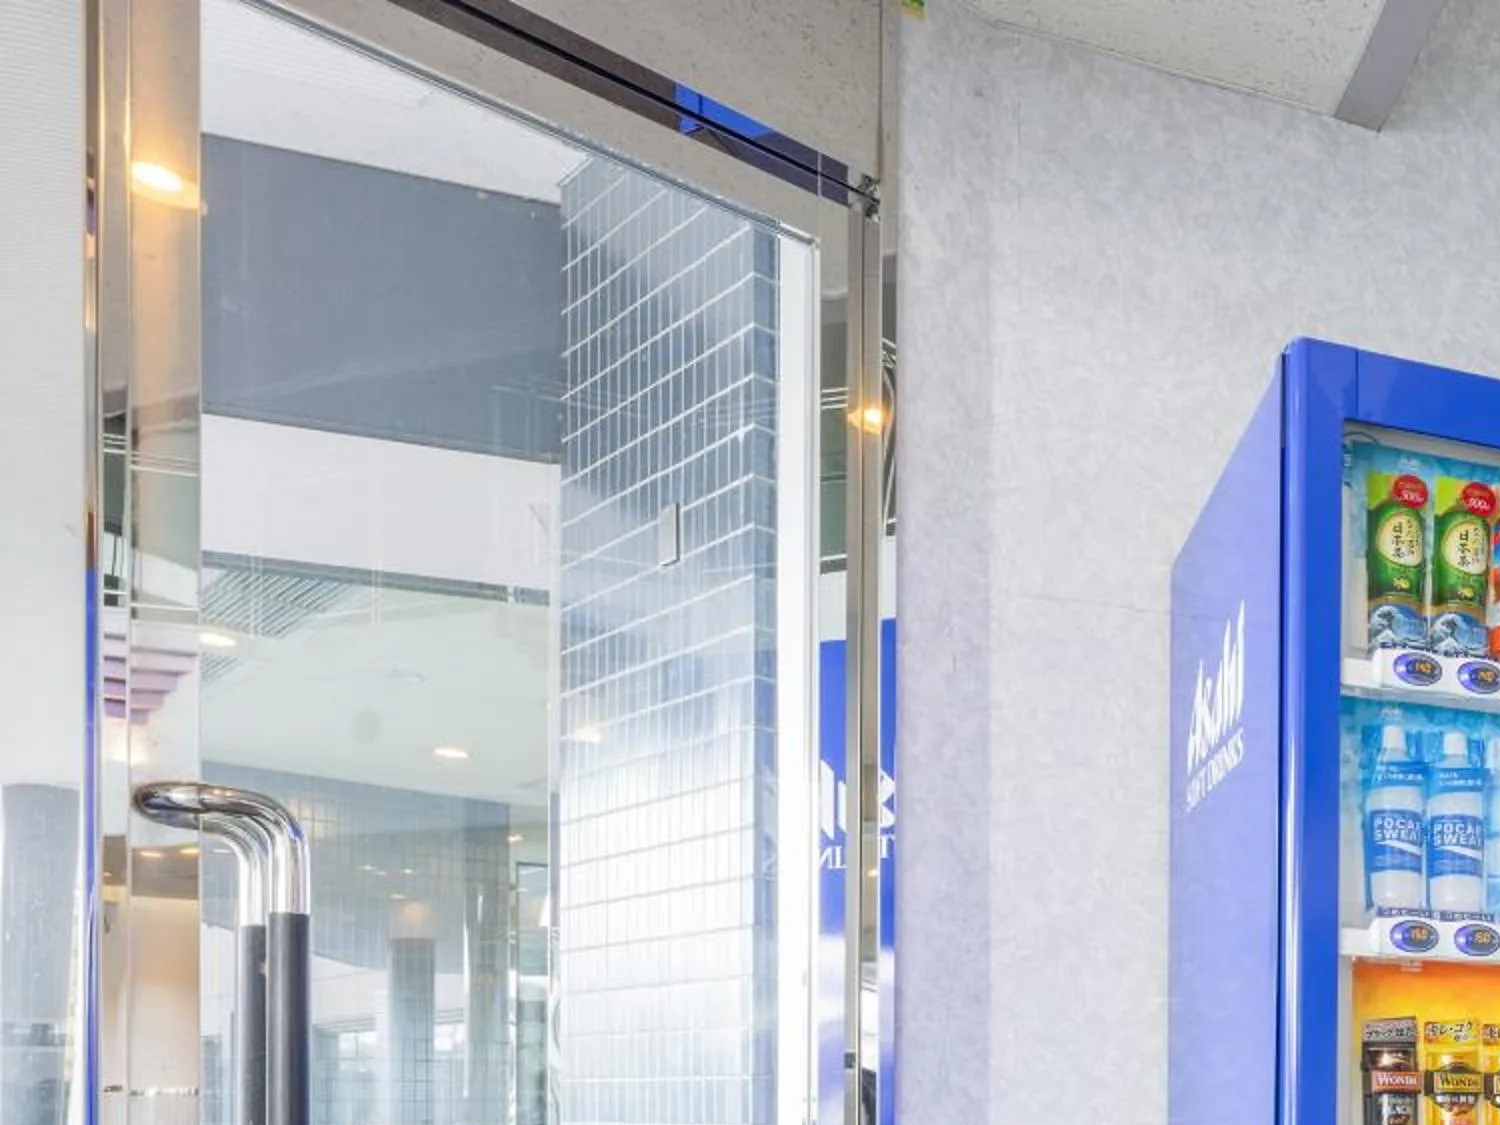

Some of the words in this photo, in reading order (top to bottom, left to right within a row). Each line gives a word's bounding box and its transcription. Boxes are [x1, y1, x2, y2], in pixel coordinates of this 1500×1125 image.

[1374, 817, 1420, 831] POCA
[1433, 822, 1481, 836] POCA
[1374, 829, 1420, 843] SWEA
